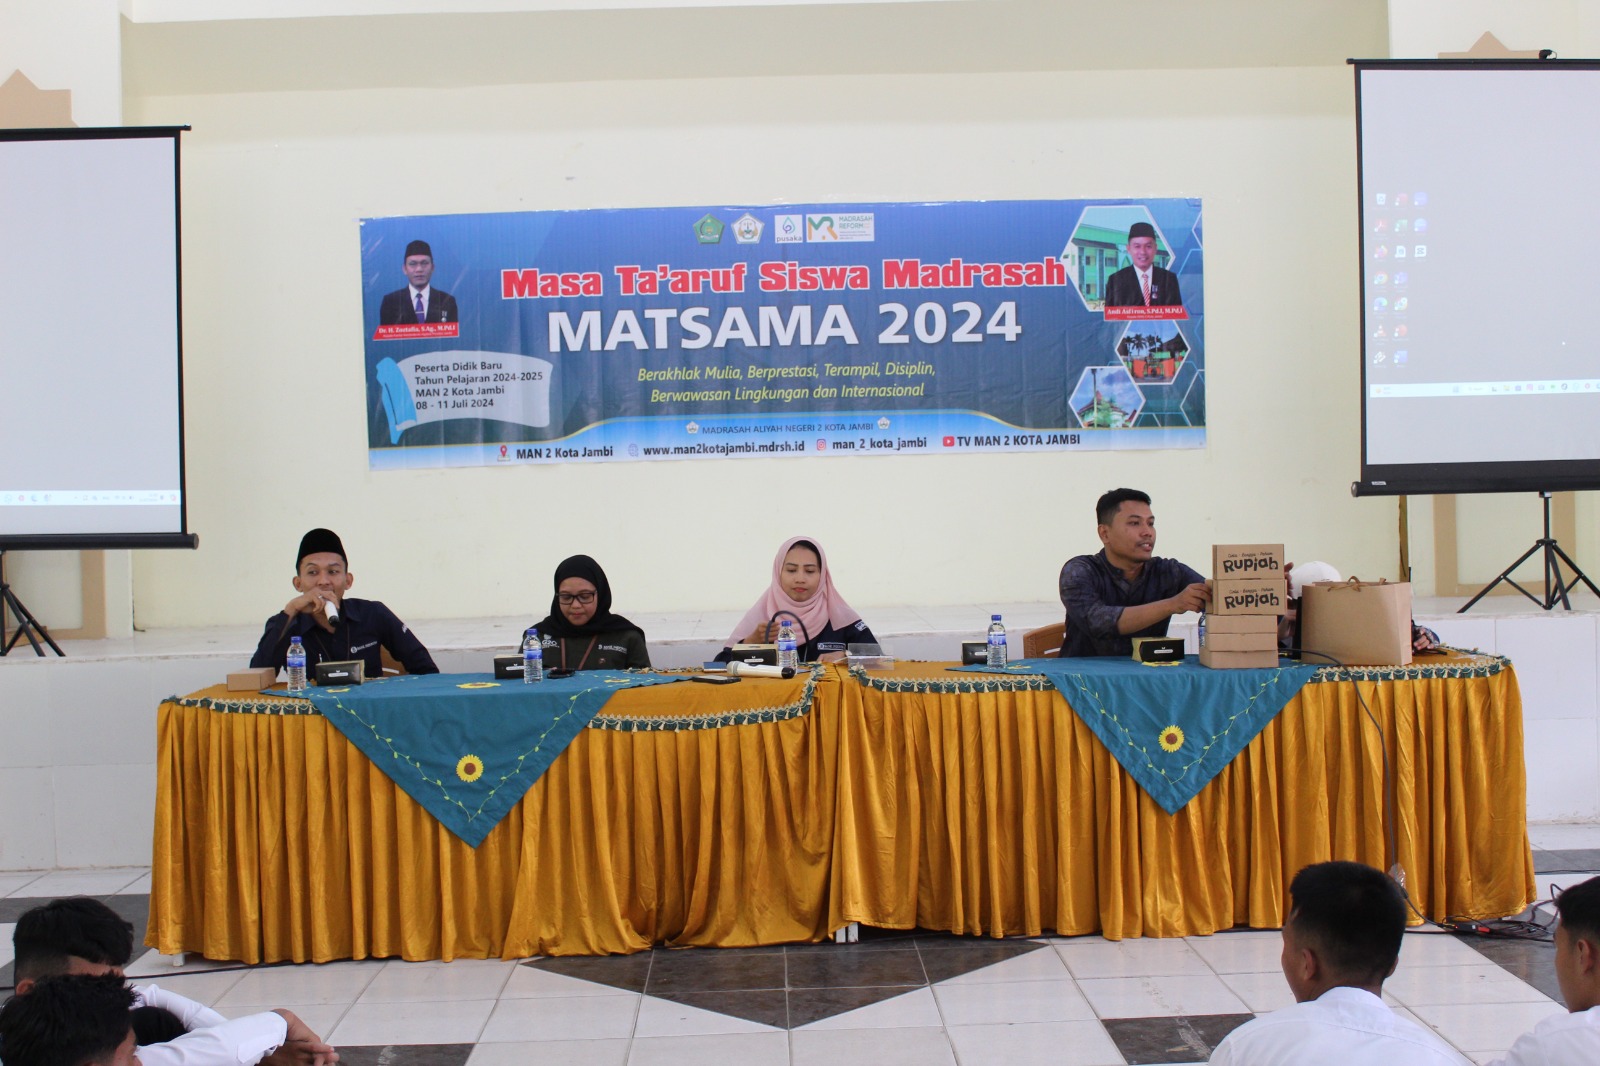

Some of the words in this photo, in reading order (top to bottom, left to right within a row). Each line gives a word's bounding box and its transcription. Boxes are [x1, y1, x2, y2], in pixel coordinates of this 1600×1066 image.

[501, 268, 603, 299] Masa
[614, 262, 747, 296] Ta'aruf
[759, 261, 870, 292] Siswa
[882, 256, 1067, 289] Madrasah
[548, 304, 859, 352] MATSAMA
[878, 301, 1022, 344] 2024
[414, 364, 449, 373] Peserta
[452, 362, 477, 371] Didik
[480, 361, 502, 370] Baru
[638, 366, 701, 381] Berakhlak
[704, 365, 743, 380] Mulia,
[747, 363, 819, 381] Berprestasi,
[824, 362, 881, 379] Terampil,
[885, 361, 936, 379] Disiplin,
[415, 376, 444, 385] Tahun
[447, 374, 490, 385] Pelajaran
[493, 372, 543, 382] 2024-2025
[415, 388, 440, 398] MAN
[443, 387, 449, 396] 2
[451, 387, 474, 396] Kota
[476, 385, 505, 395] Jambi
[650, 389, 731, 402] Berwawasan
[735, 386, 809, 403] Lingkungan
[813, 385, 837, 399] dan
[841, 383, 925, 398] Internasional
[415, 401, 428, 410] 08
[437, 400, 448, 409] 11
[451, 399, 468, 408] Juli
[471, 398, 494, 408] 2024
[702, 426, 751, 434] MADRASAH
[753, 425, 782, 433] ALIYAH
[785, 424, 815, 432] NEGERI
[824, 423, 846, 431] KOTA
[832, 437, 927, 451] man_2_kota_jambi
[957, 436, 971, 446] TV
[974, 436, 1000, 446] MAN
[1004, 435, 1010, 445] 2
[1013, 435, 1043, 445] KOTA
[1046, 434, 1080, 444] JAMBI
[516, 449, 542, 459] MAN
[545, 448, 551, 458] 2
[555, 447, 579, 458] Kota
[582, 446, 613, 457] Jambi
[643, 440, 805, 457] www.man2kotajambi.mdrsh.id
[1223, 557, 1279, 573] Rupiah
[1224, 593, 1280, 609] Rupiah
